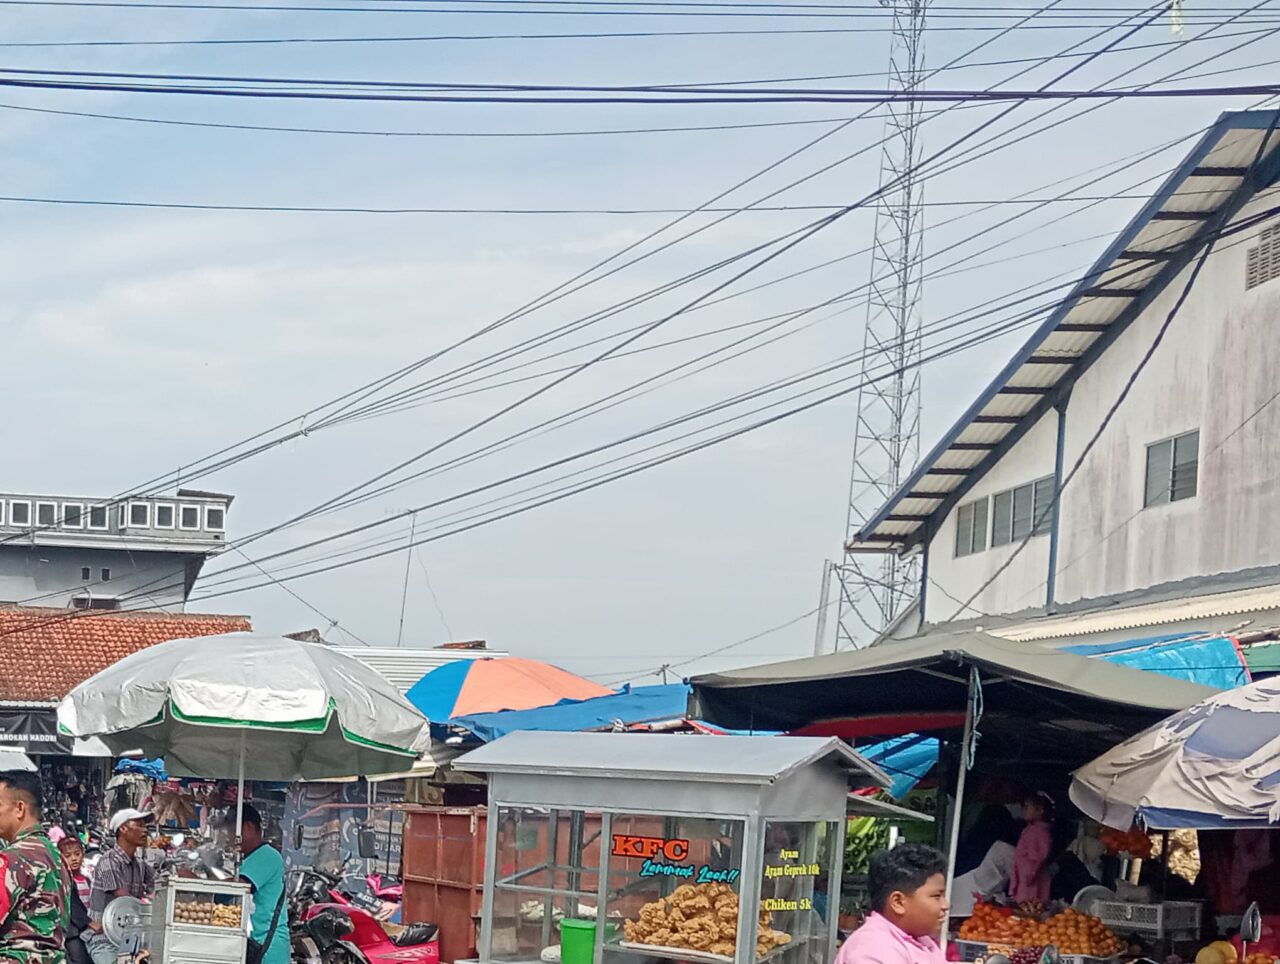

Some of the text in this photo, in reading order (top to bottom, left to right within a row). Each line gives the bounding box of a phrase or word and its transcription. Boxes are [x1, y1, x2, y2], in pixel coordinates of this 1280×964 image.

[613, 835, 689, 860] KFC
[780, 848, 799, 861] Ayam
[765, 864, 783, 879] Ayam
[784, 864, 807, 878] Geprek
[765, 898, 812, 911] Chiken 5k
